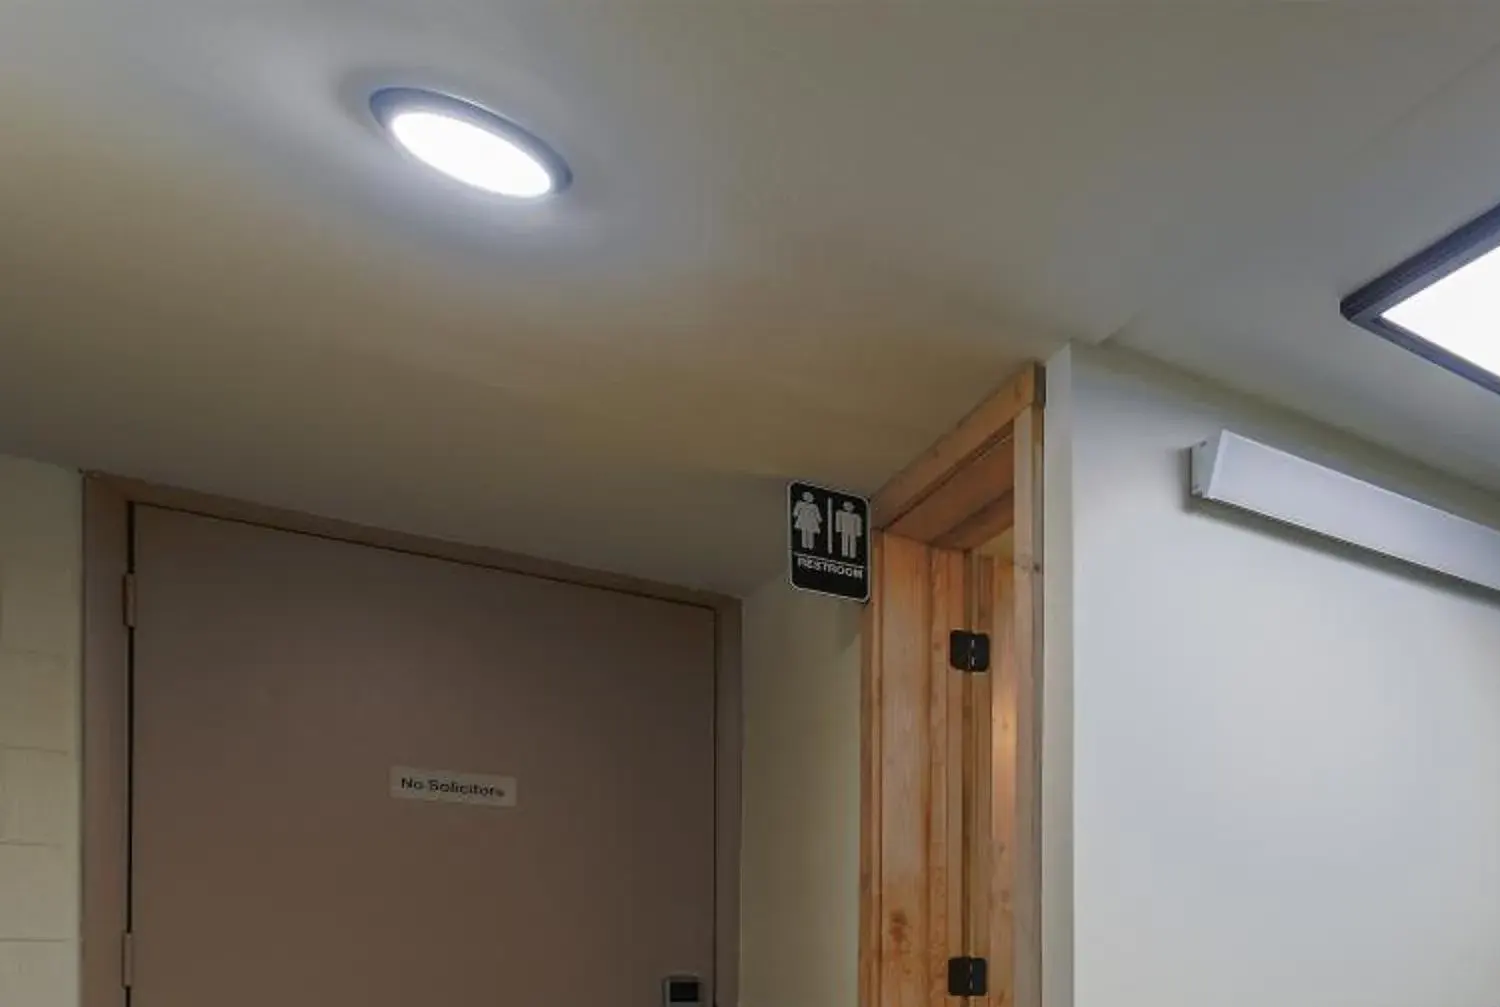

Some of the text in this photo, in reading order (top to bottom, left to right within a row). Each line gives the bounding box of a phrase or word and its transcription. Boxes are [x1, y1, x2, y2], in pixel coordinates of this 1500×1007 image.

[797, 557, 864, 579] RESTROOM
[401, 777, 505, 797] No Solicitors
